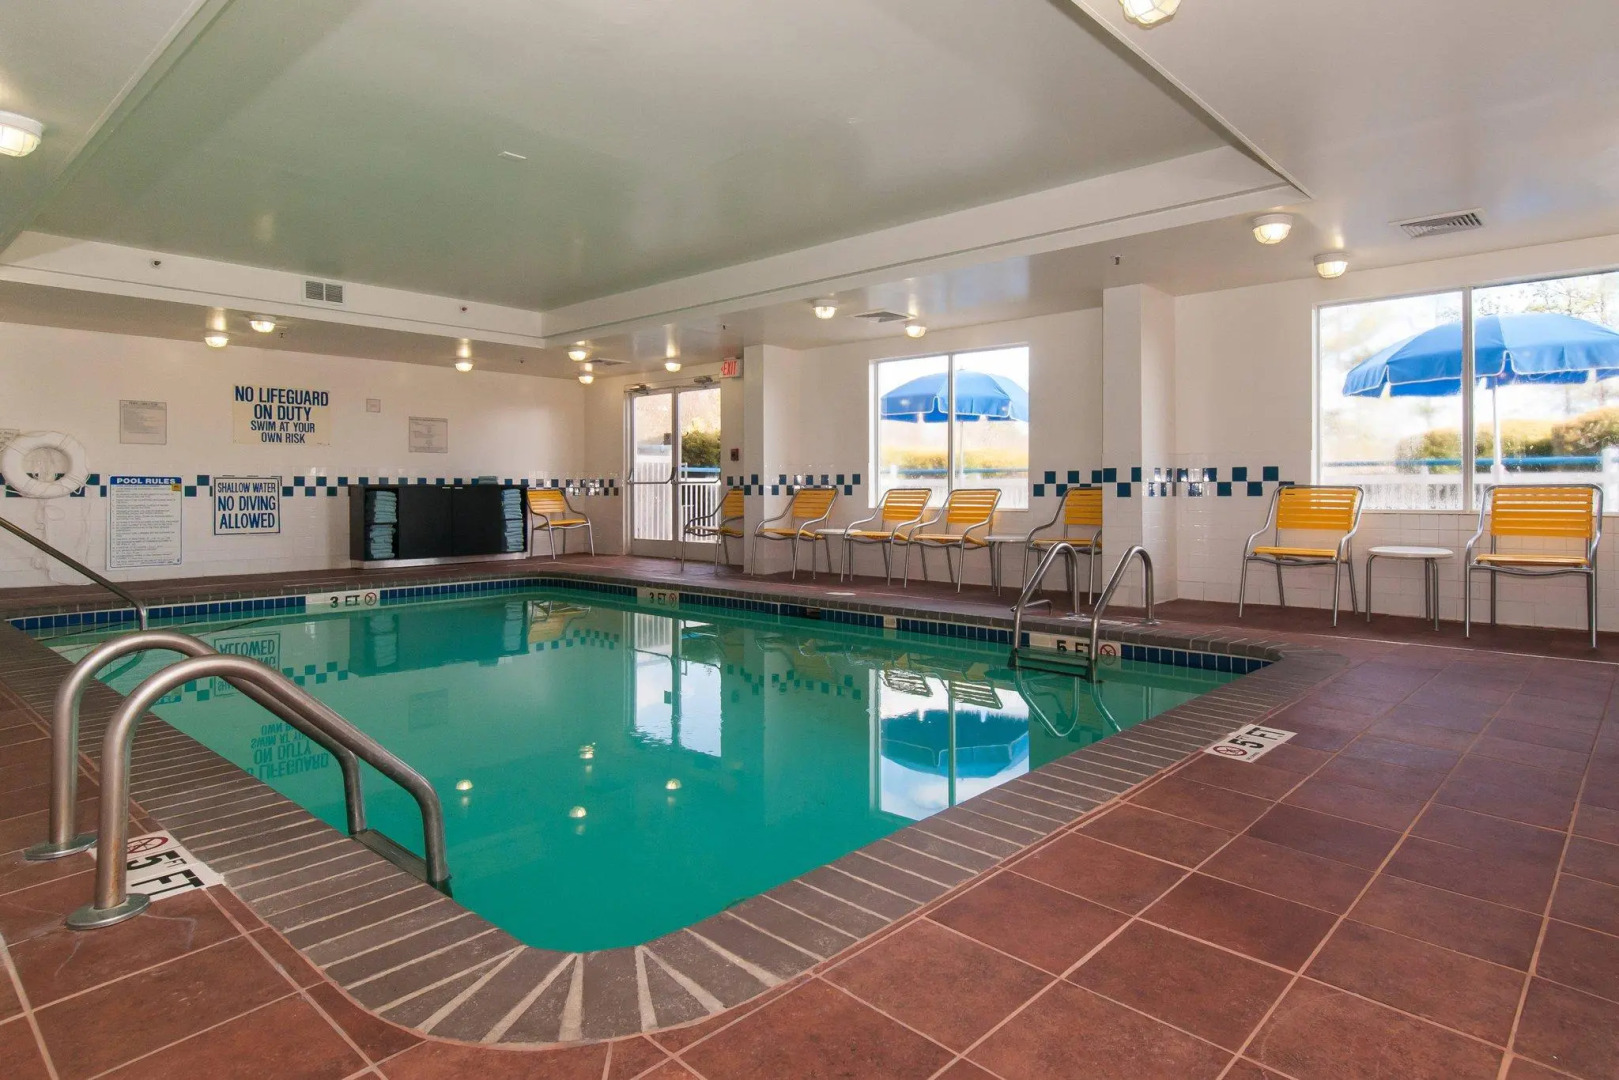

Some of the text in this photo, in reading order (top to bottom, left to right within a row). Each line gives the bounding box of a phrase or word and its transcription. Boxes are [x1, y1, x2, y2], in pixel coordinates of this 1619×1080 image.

[723, 361, 737, 375] EXIT
[235, 386, 329, 406] NO LIFEGUARD
[254, 404, 311, 421] ON DUTY
[251, 420, 315, 433] SWIM AT YOUR
[261, 432, 306, 444] OWN RISK
[217, 482, 276, 493] SHALLOW WATER
[218, 495, 276, 511] NO DIVING
[219, 512, 275, 529] ALLOWED
[1245, 727, 1286, 741] FT
[1228, 738, 1264, 749] 5
[126, 850, 180, 870] 5
[131, 869, 205, 897] FT
